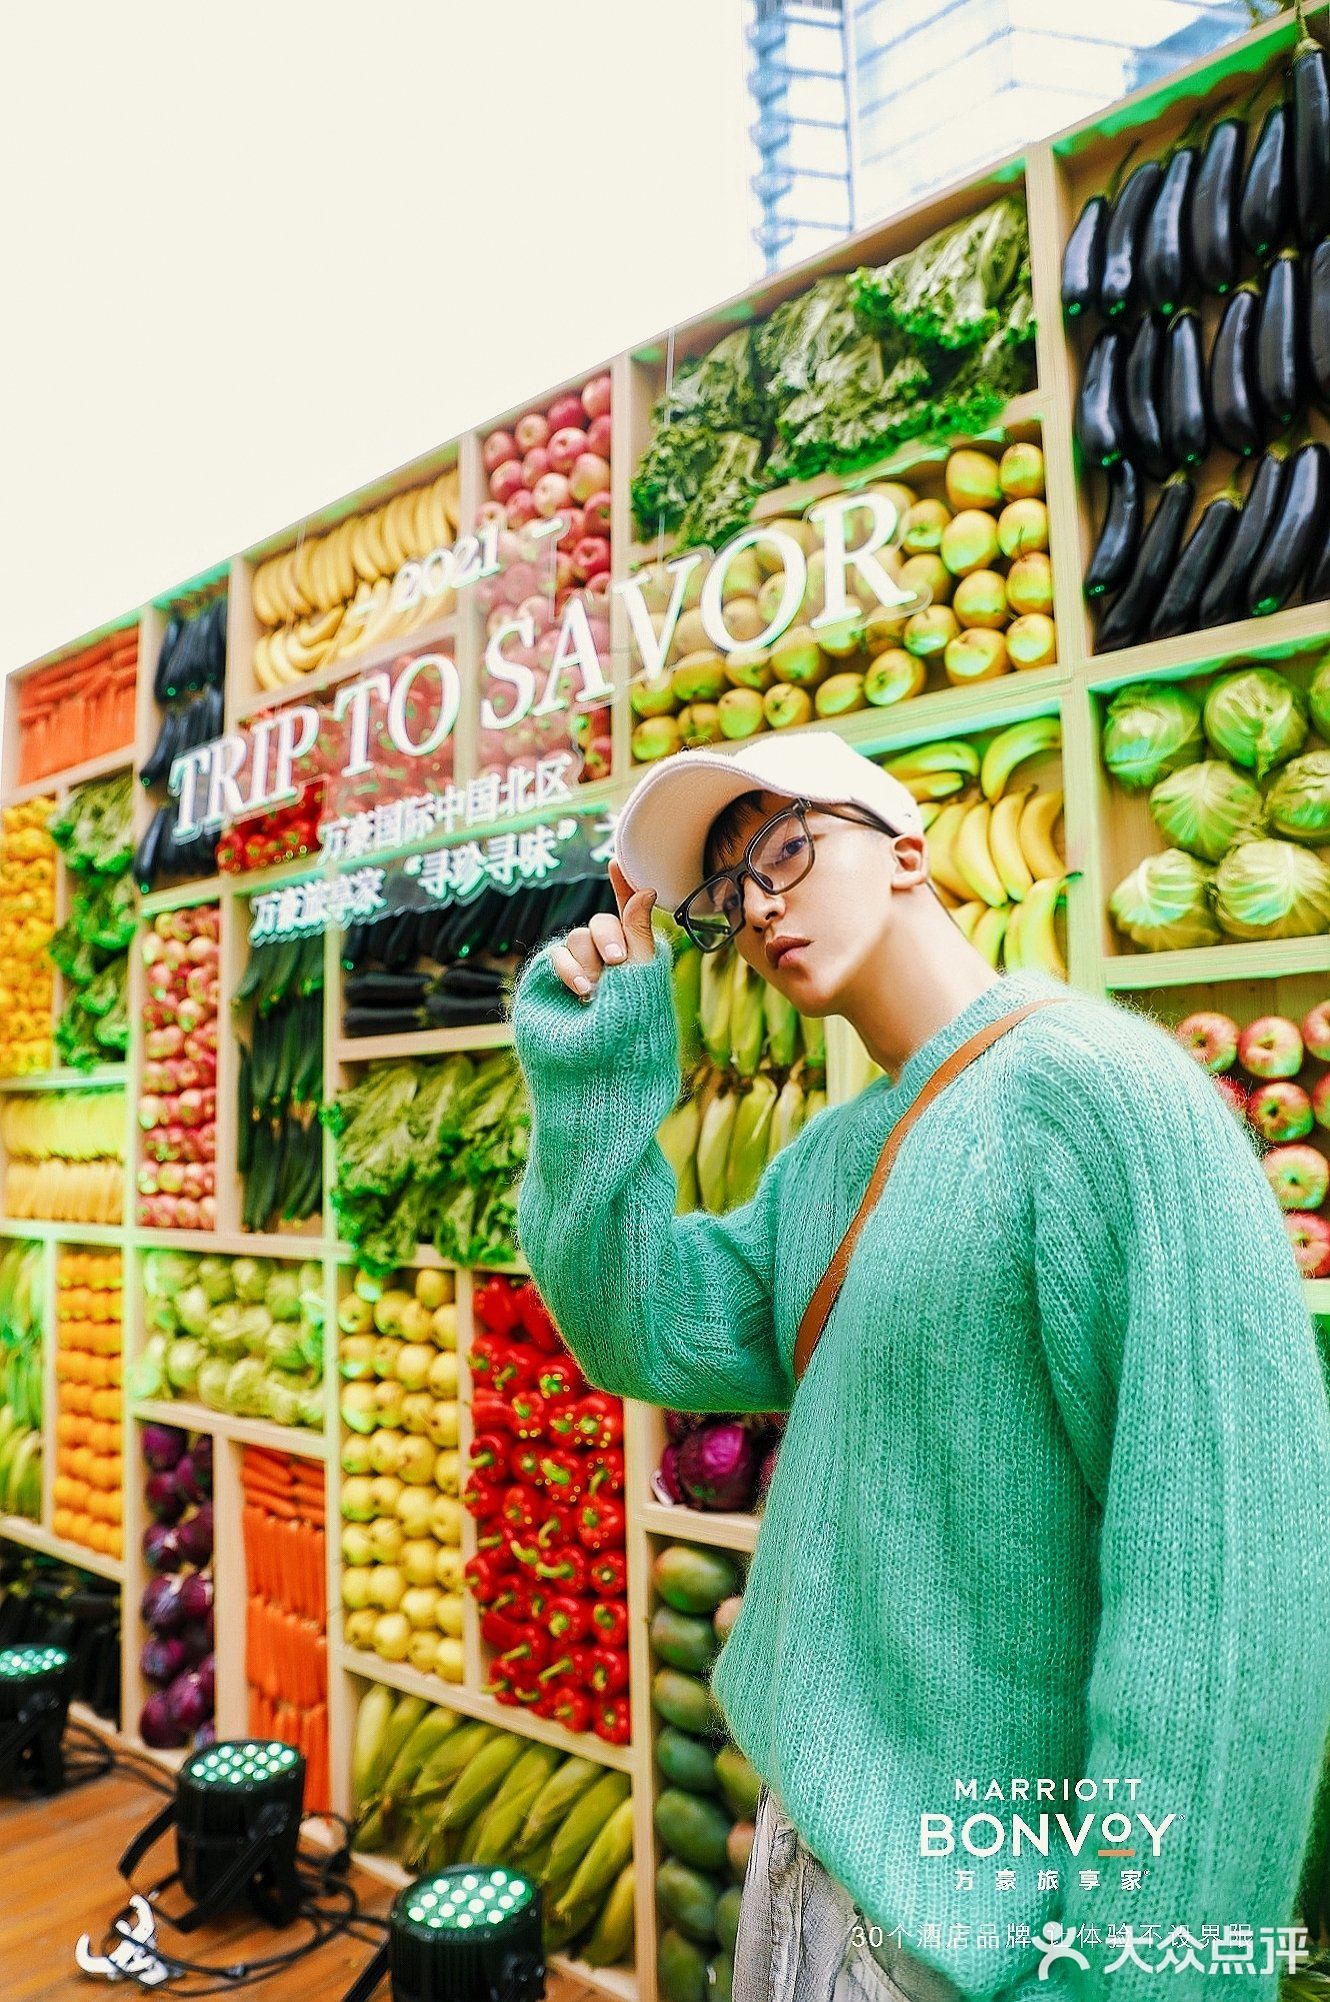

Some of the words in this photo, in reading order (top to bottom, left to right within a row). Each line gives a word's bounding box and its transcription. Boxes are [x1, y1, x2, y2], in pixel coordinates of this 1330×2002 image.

[393, 524, 501, 613] 2021
[168, 706, 320, 846] TRIP
[333, 652, 462, 778] TO
[481, 493, 918, 731] SAVOR
[316, 752, 574, 864] 万豪国际中国北区
